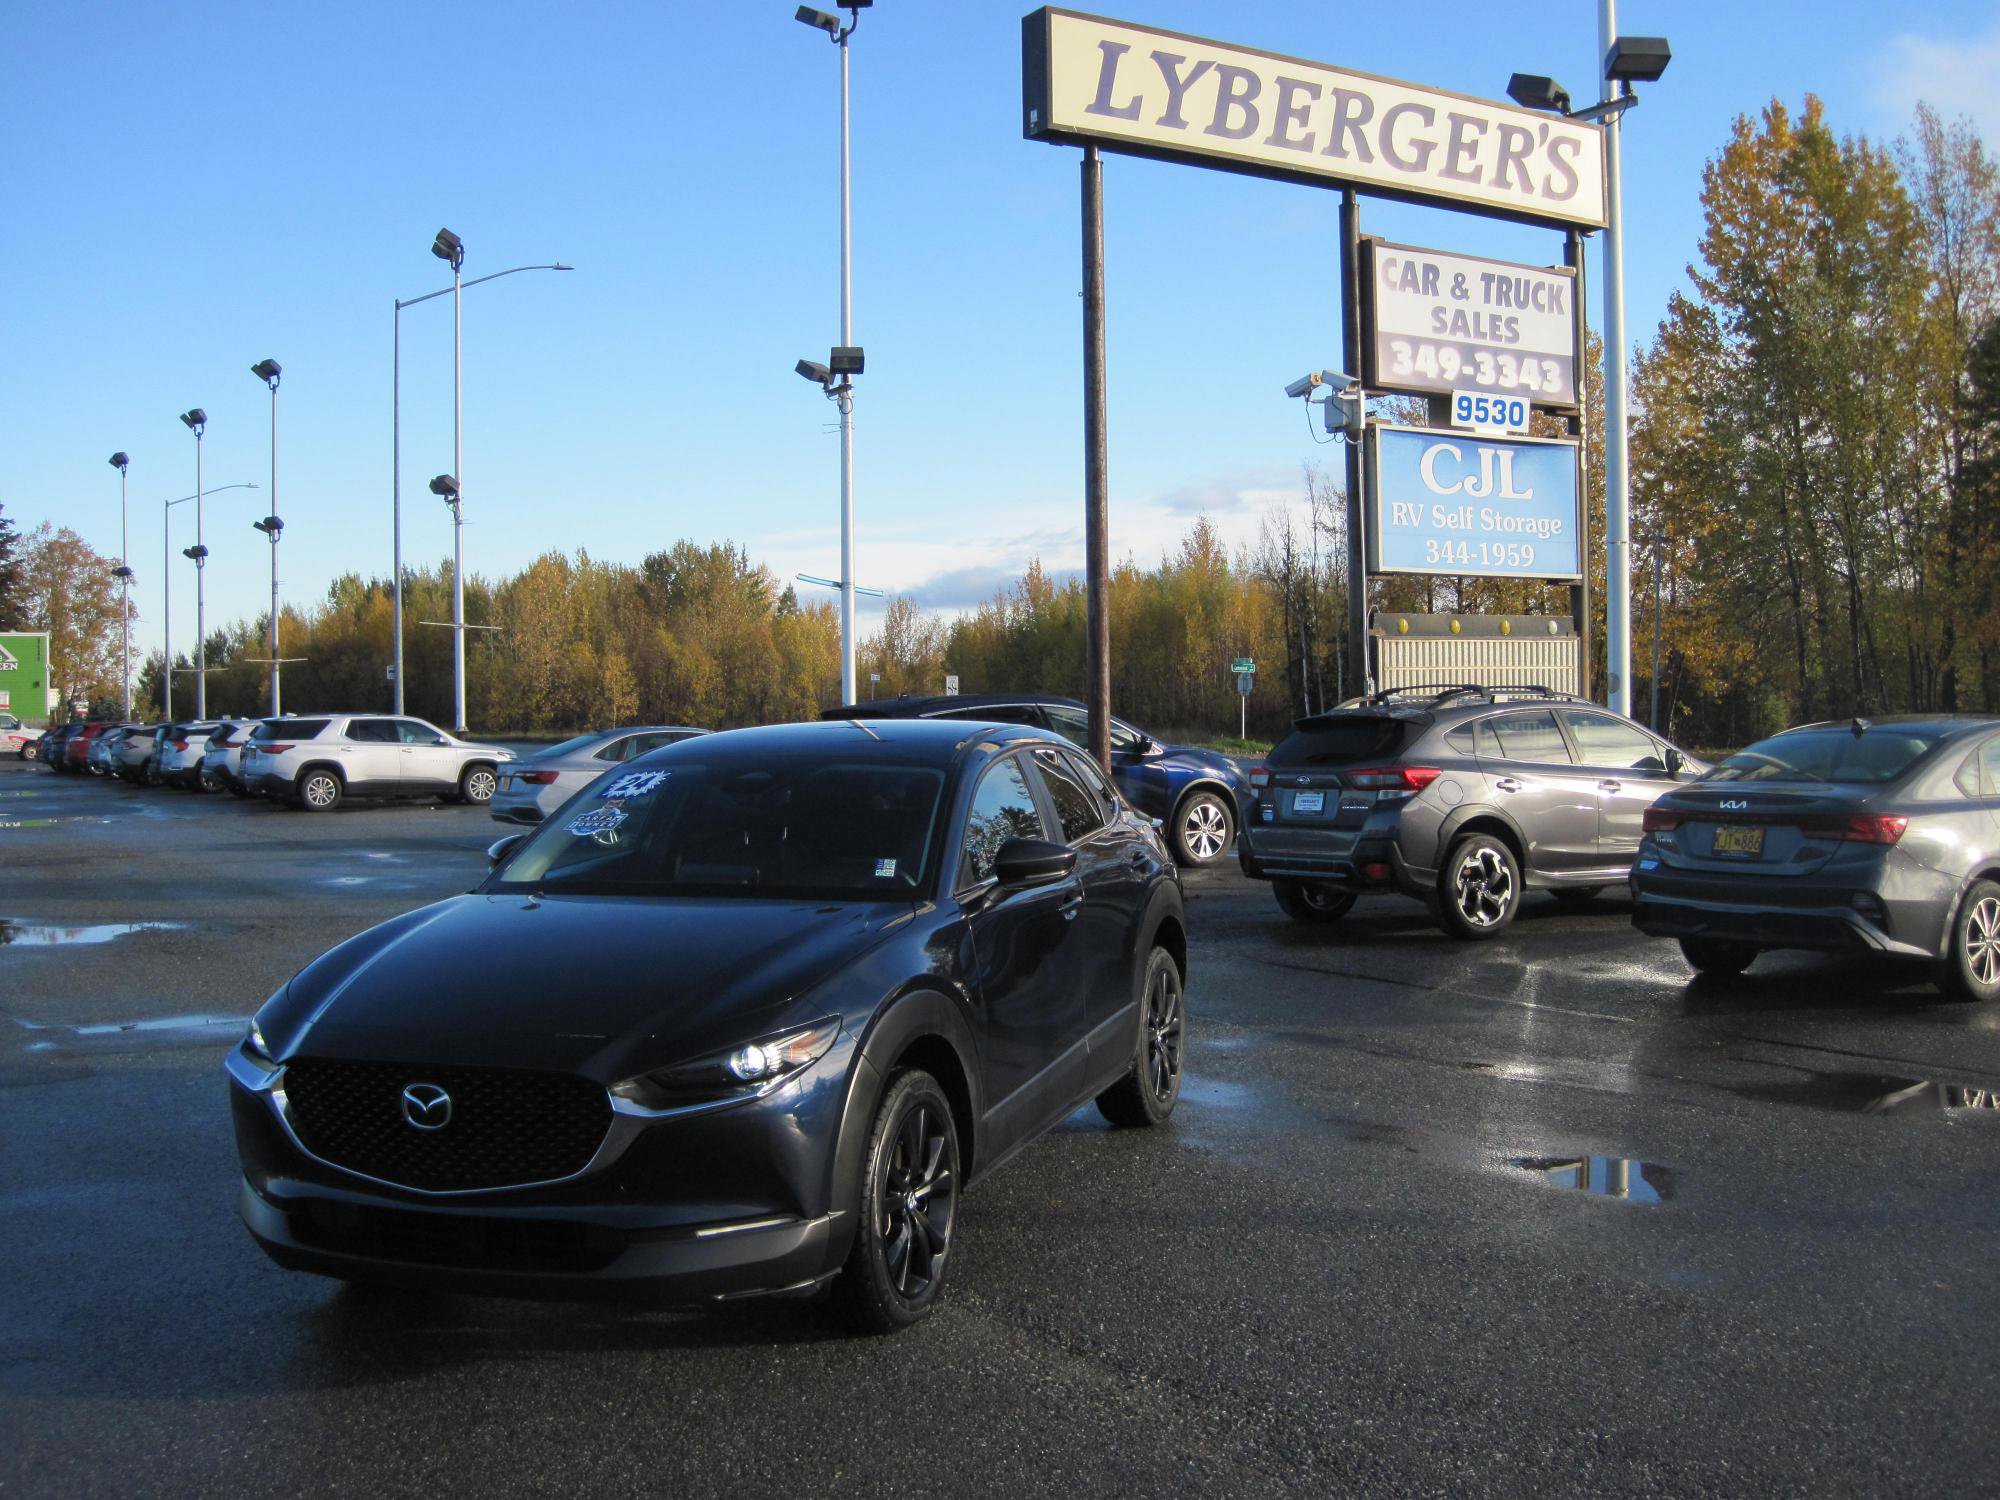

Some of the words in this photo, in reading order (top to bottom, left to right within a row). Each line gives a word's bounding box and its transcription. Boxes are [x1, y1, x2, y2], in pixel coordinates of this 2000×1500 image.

[1085, 40, 1582, 201] LYBERGER'S
[1381, 257, 1440, 297] CAR
[1450, 272, 1470, 301] &
[1480, 271, 1565, 315] TRUCK
[1431, 306, 1520, 344] SALES
[1391, 340, 1563, 393] 349-3343
[1457, 395, 1524, 427] 9530
[1420, 443, 1534, 500] CJL
[1391, 502, 1424, 529] RV
[1431, 504, 1473, 530] Self
[1480, 508, 1562, 539] Storage
[1426, 539, 1535, 567] 344-1959
[1719, 800, 1747, 809] KIA
